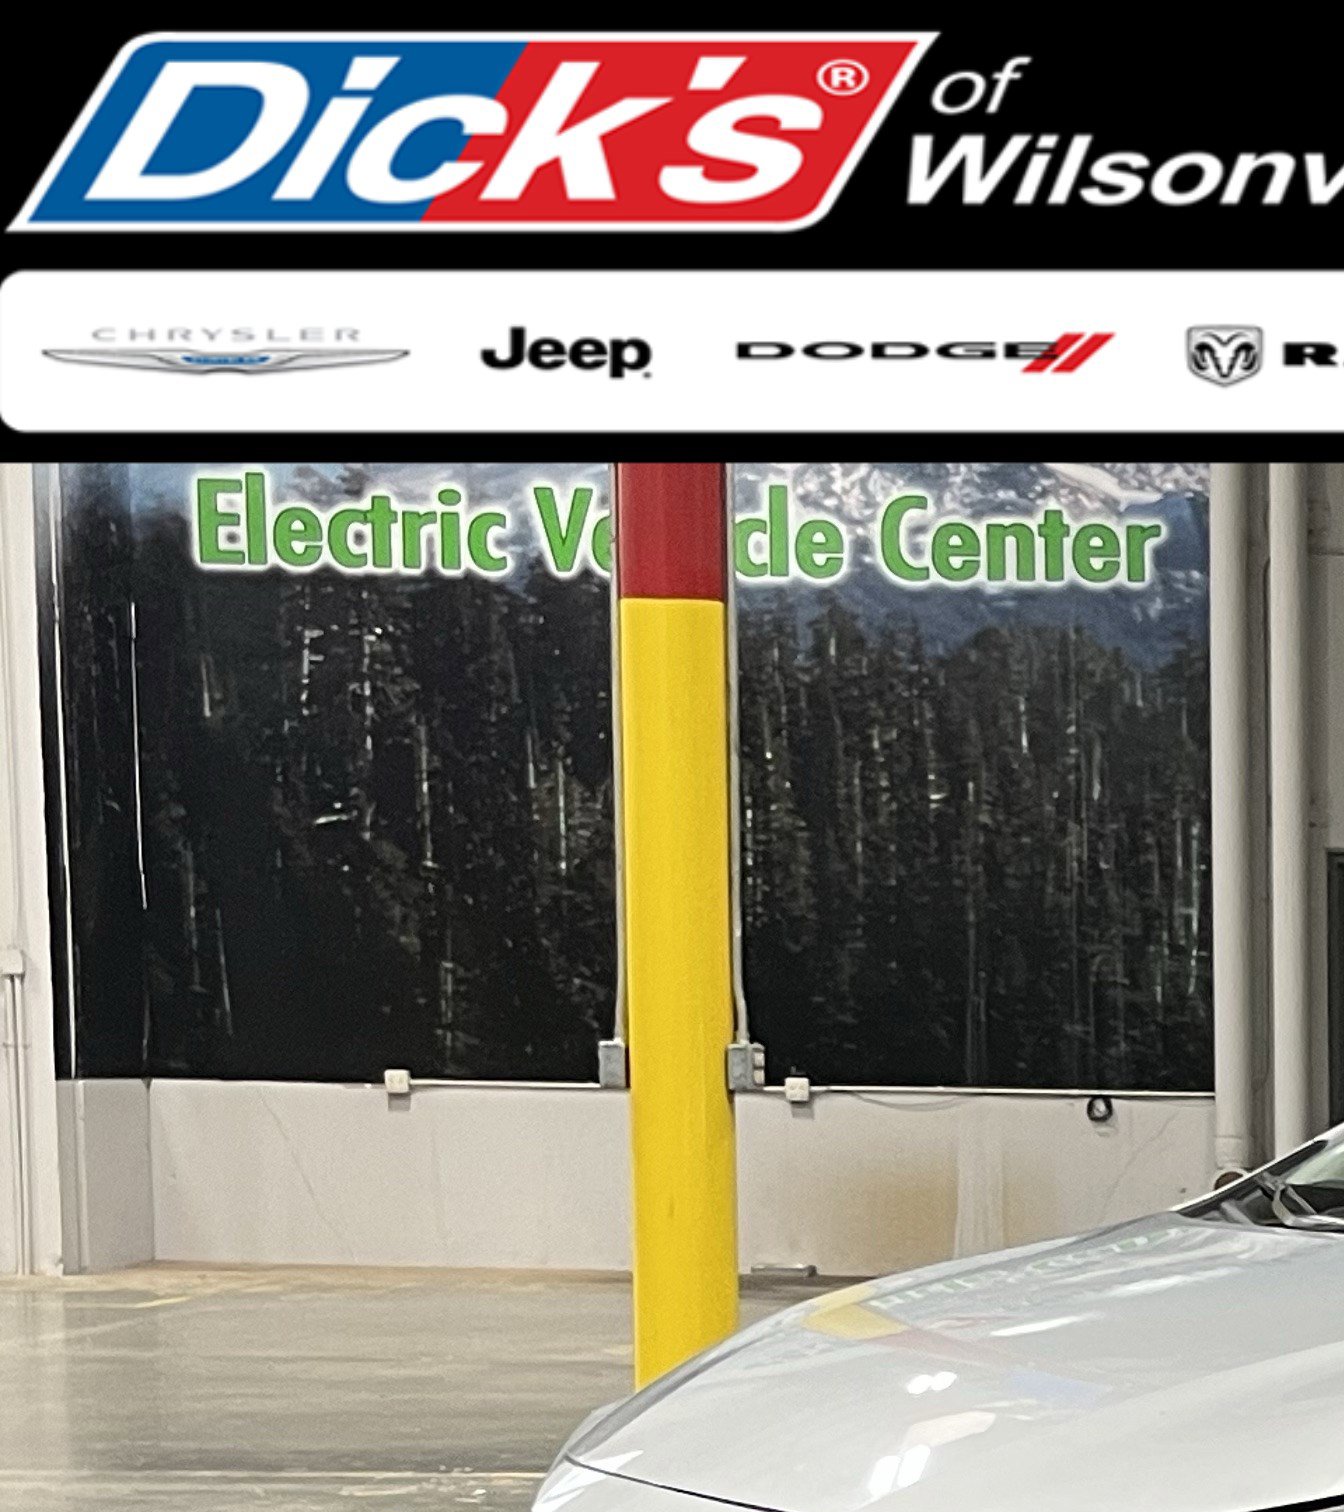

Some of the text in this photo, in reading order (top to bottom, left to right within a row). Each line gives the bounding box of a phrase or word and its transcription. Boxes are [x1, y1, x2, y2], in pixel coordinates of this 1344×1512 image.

[195, 471, 1162, 583] Electric Vcle Center
